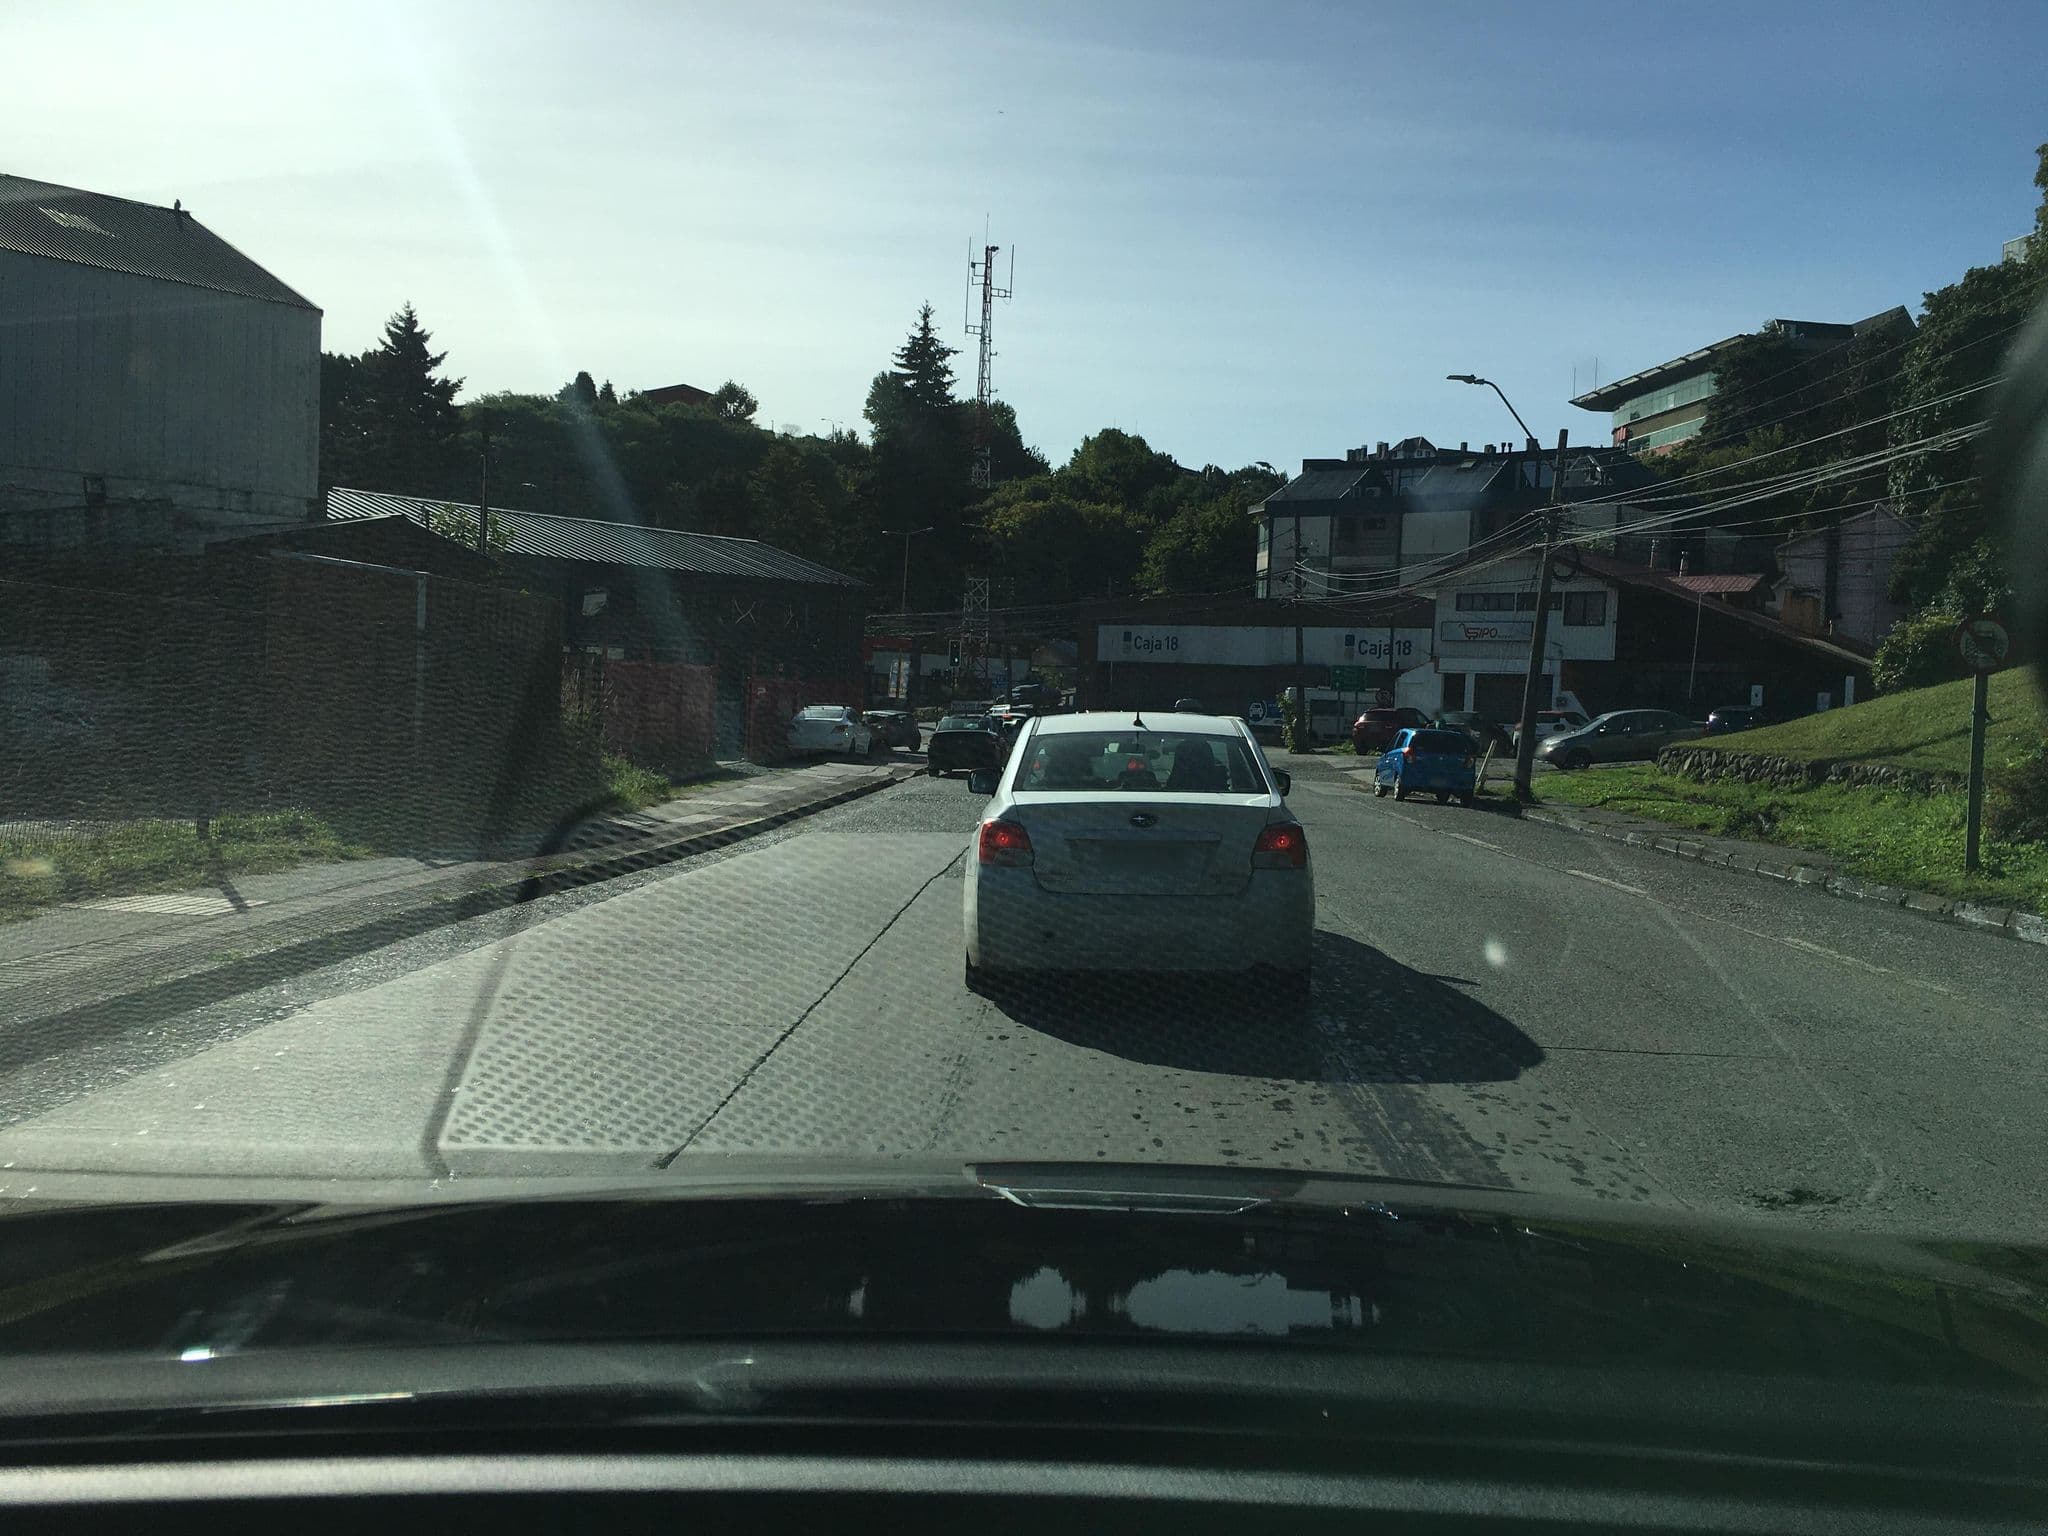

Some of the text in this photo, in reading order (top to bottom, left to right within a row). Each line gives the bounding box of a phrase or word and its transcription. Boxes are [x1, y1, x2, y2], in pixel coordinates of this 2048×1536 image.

[1134, 635, 1178, 654] Caja 18
[1358, 639, 1412, 659] Caja 18
